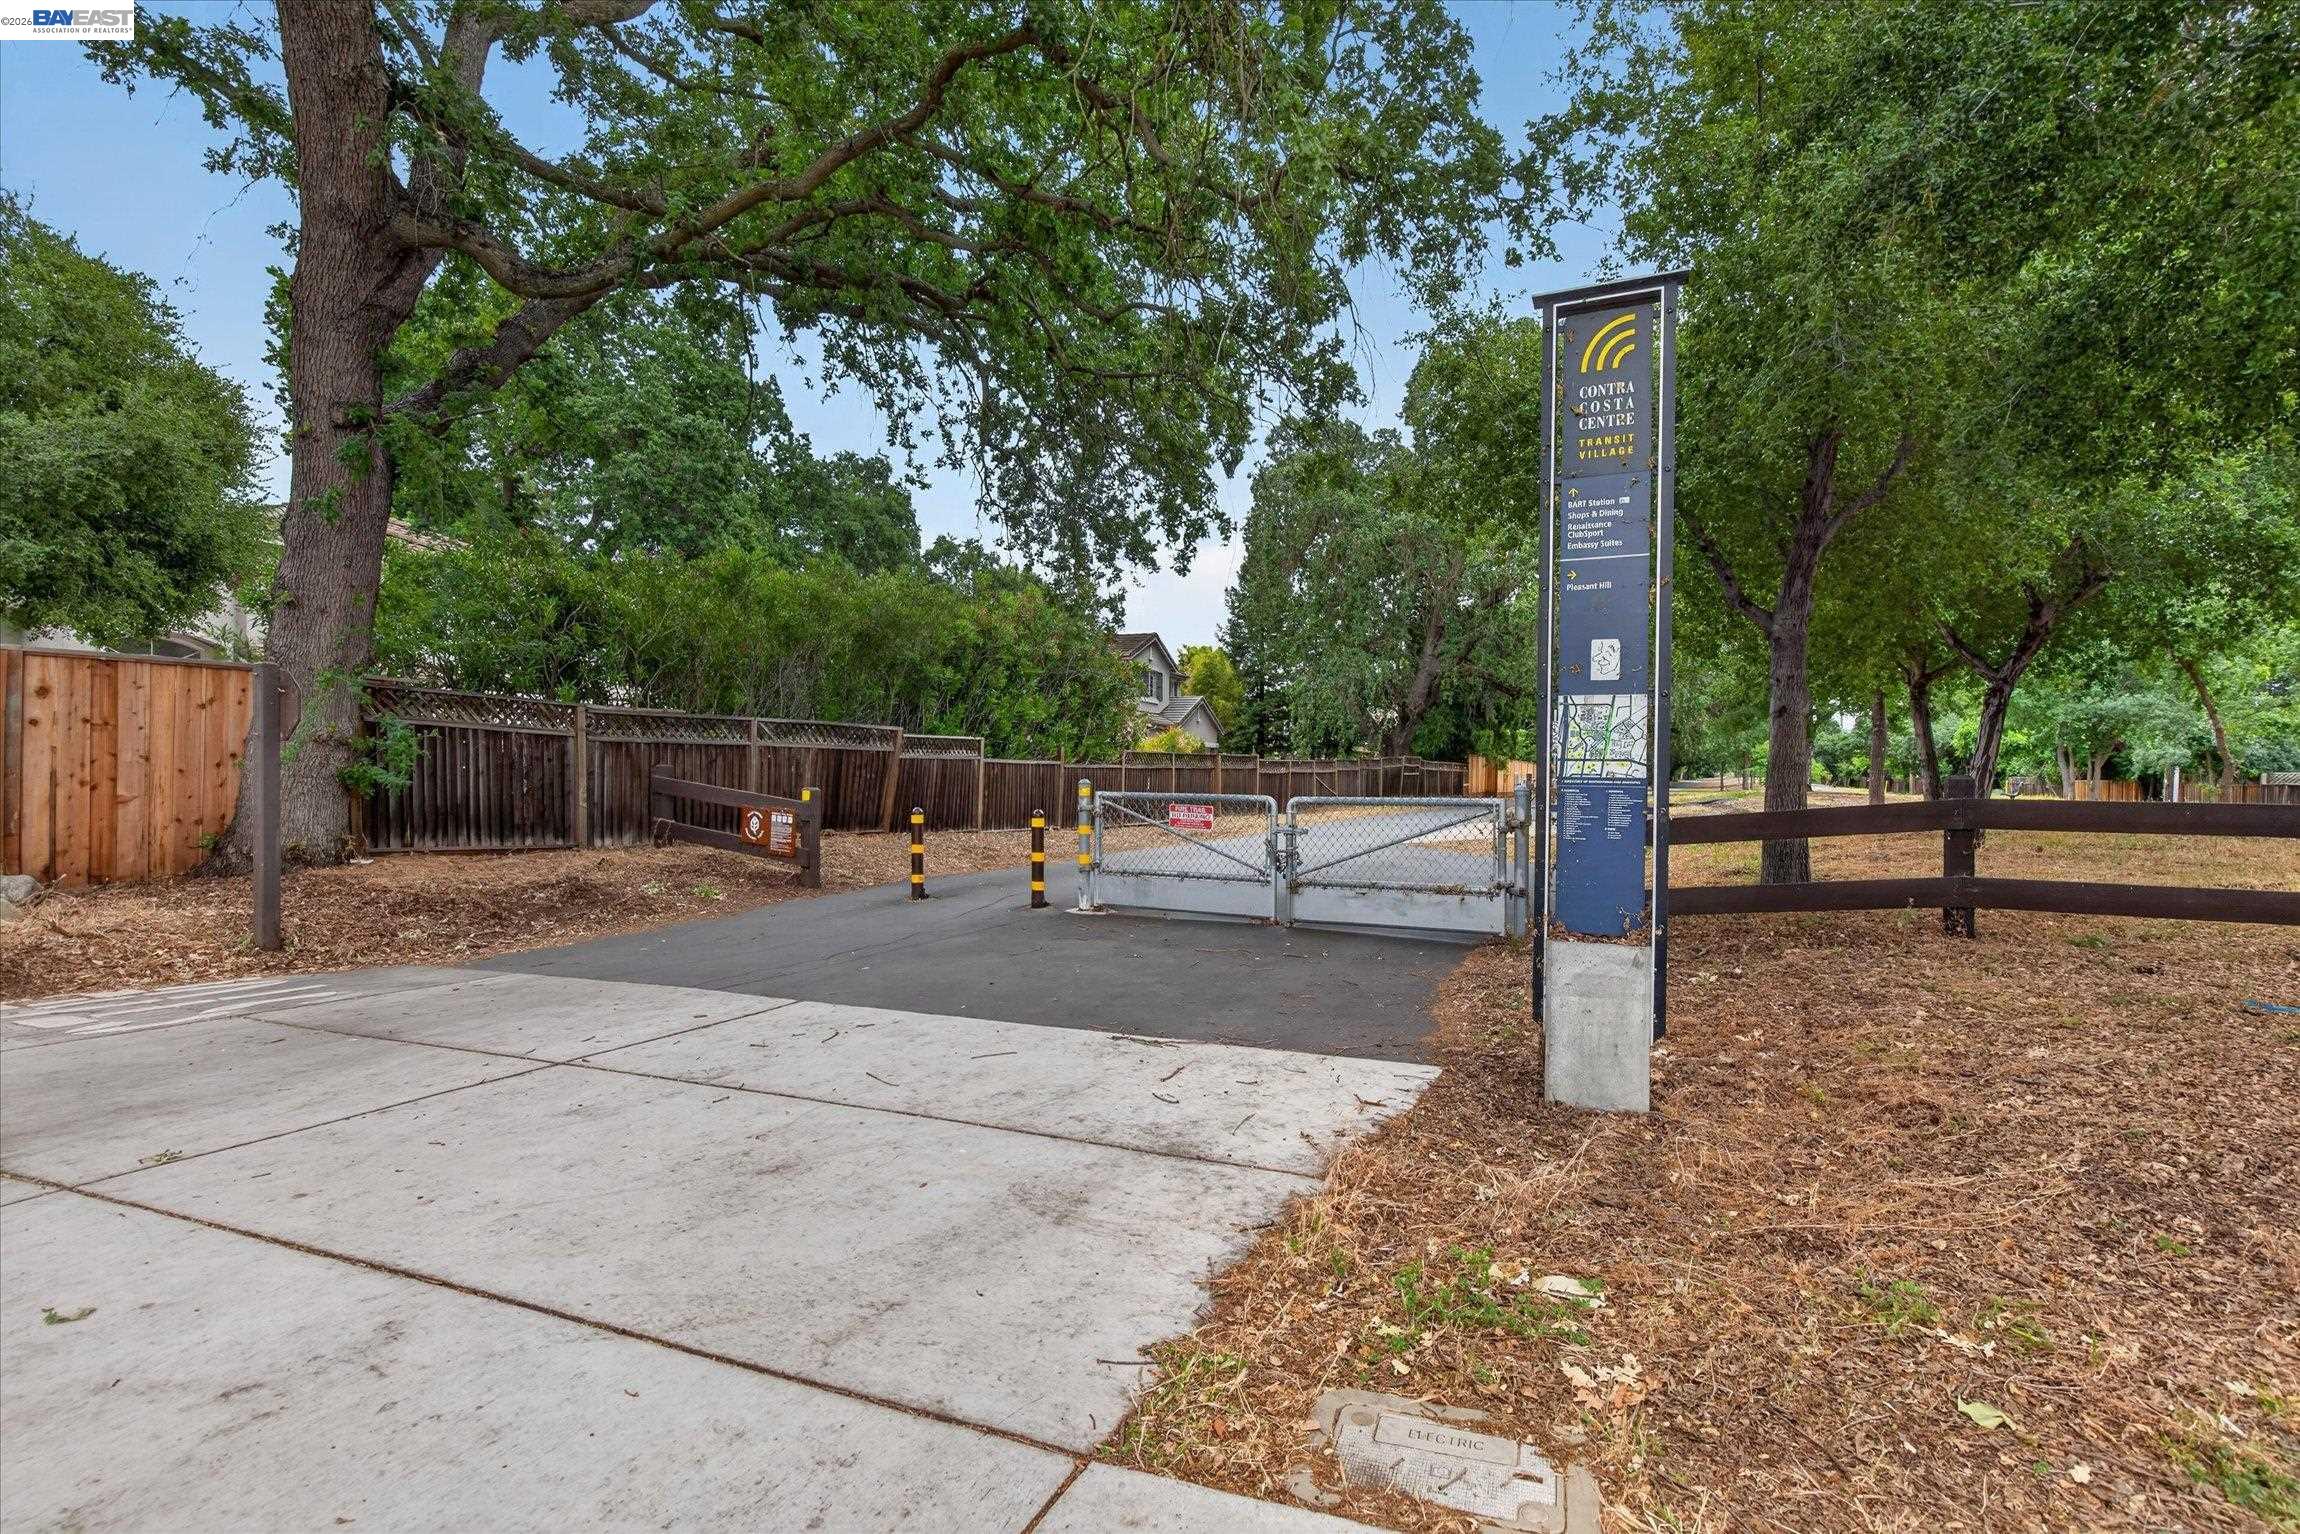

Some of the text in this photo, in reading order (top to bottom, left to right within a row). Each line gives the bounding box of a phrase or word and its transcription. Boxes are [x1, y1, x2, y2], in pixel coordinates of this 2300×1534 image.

[1579, 381, 1634, 399] CONTRA
[1580, 397, 1634, 414] COSTA
[1579, 412, 1635, 431] CENTRE
[1578, 433, 1634, 448] TRANSIT
[1578, 446, 1633, 460] VILLAGE
[1568, 500, 1586, 509] BART
[1588, 498, 1615, 507] Station
[1567, 511, 1590, 520] Shops
[1599, 508, 1624, 517] Dining
[1567, 522, 1612, 531] Renaissance
[1567, 530, 1604, 539] ClubSport
[1567, 541, 1599, 550] Embassy
[1566, 581, 1612, 591] Pleasant Hill
[1407, 1429, 1485, 1451] ELECTRIC
